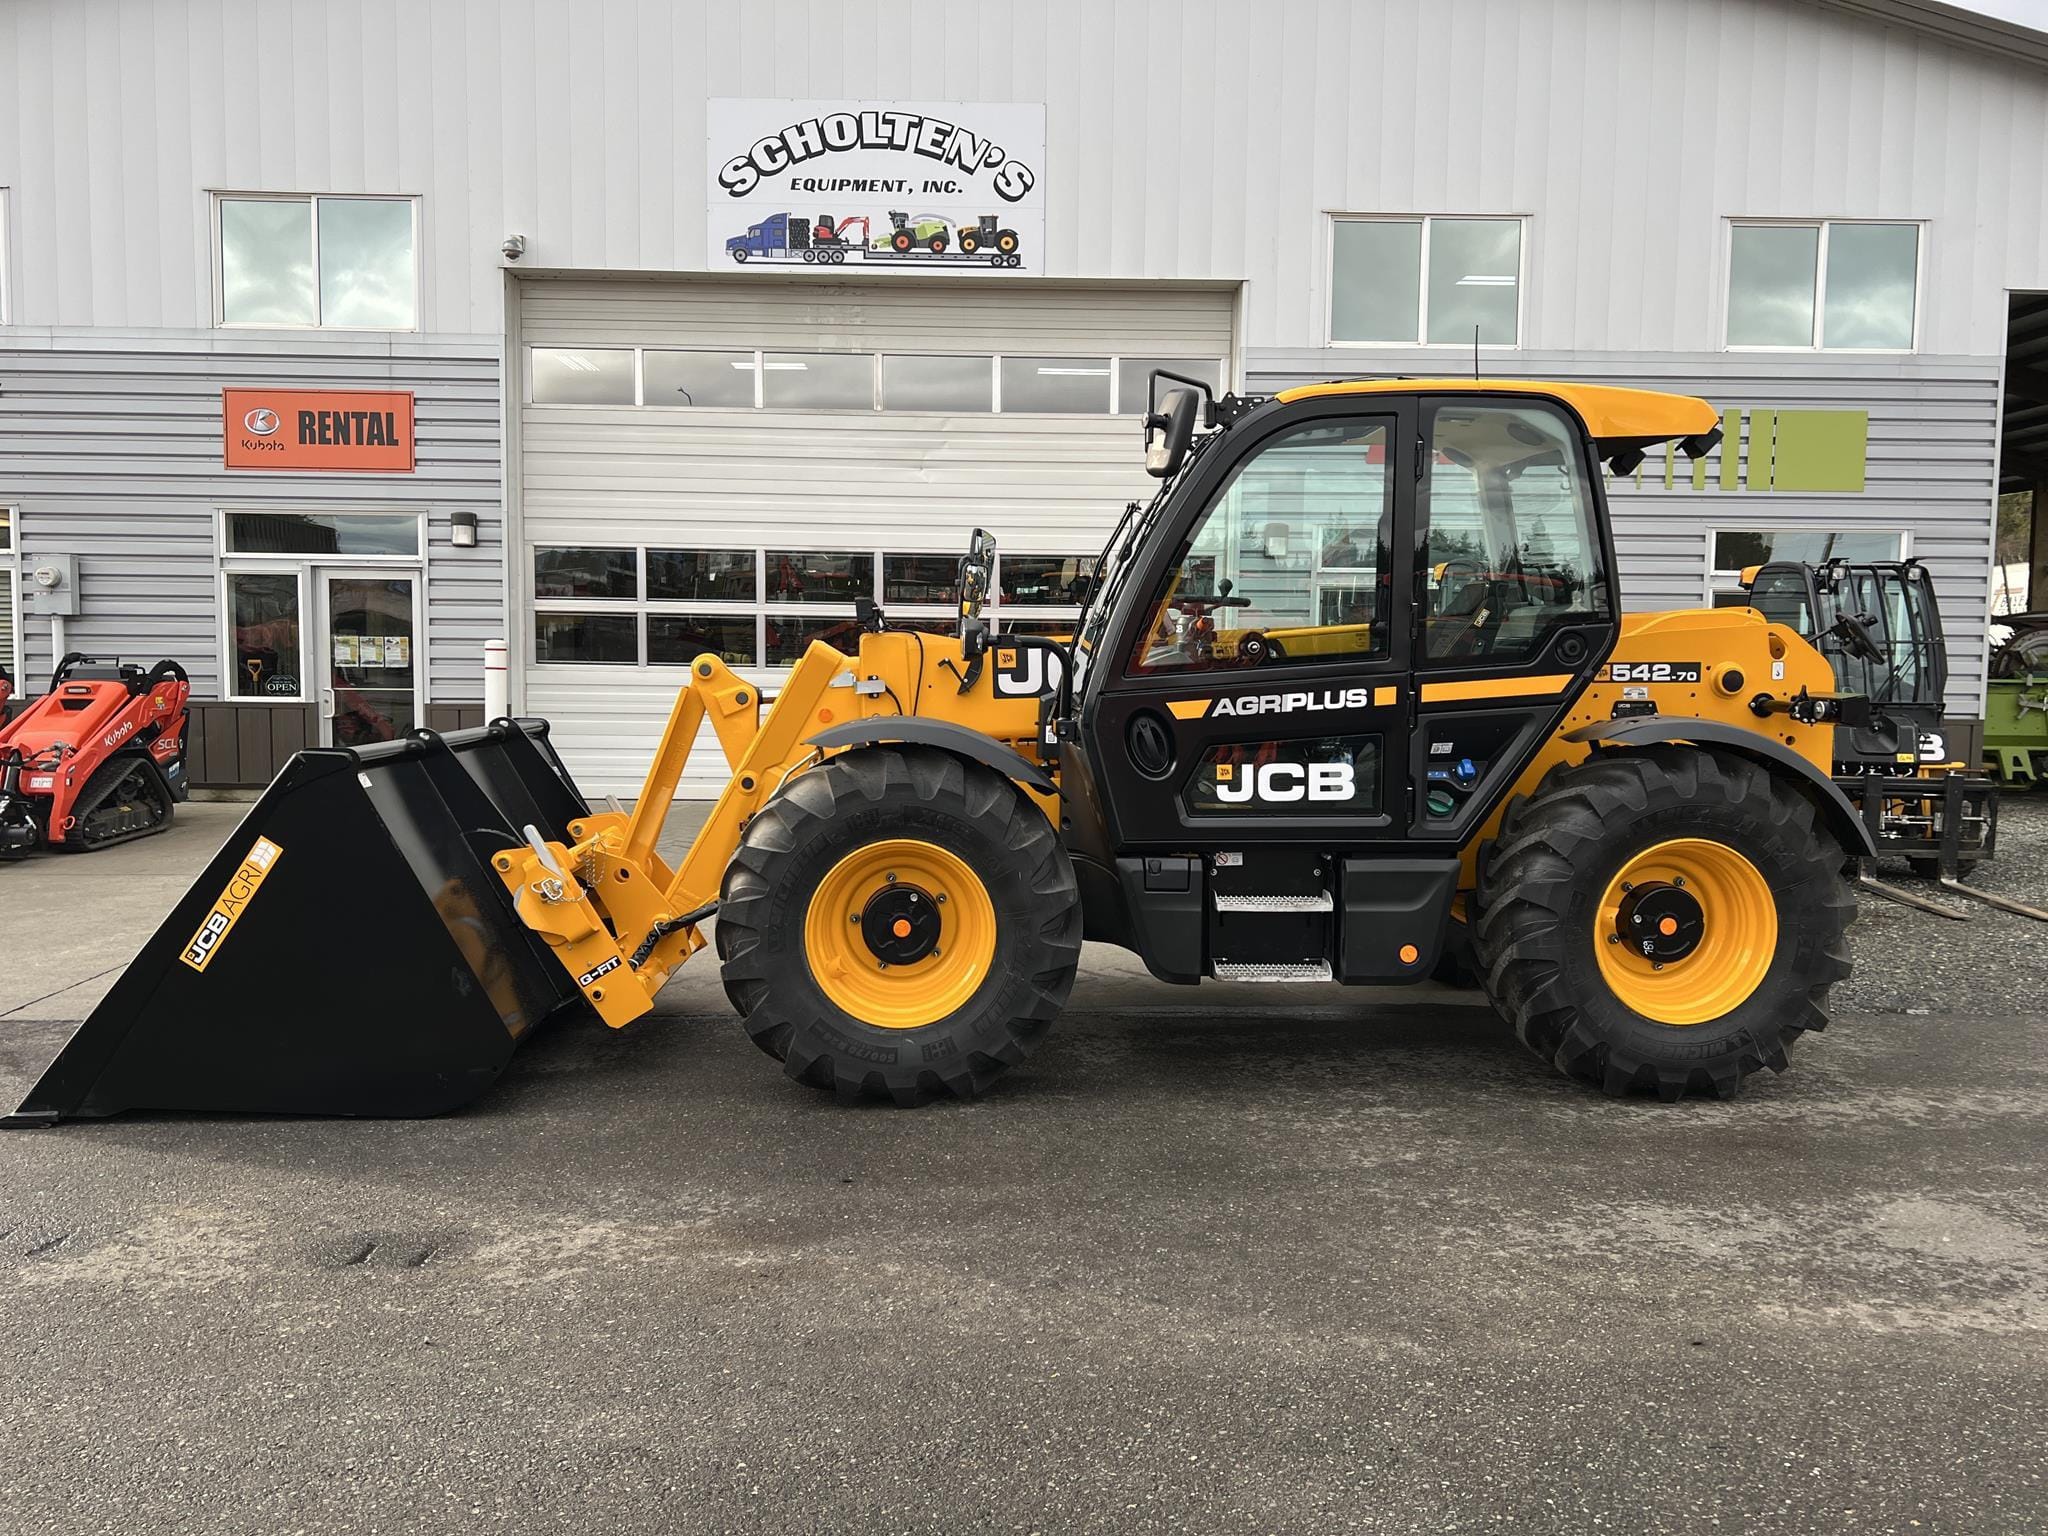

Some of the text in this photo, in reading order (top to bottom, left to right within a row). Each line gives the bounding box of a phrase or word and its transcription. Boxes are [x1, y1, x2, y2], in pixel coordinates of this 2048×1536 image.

[718, 111, 1035, 202] SCHOLTEN'S
[790, 178, 964, 195] EQUIPMENT, INC.
[298, 410, 399, 446] RENTAL
[241, 439, 285, 451] Kubota
[1611, 663, 1698, 682] 542-70
[267, 683, 297, 691] OPEN
[1211, 688, 1367, 717] AGRIPLUS
[103, 721, 133, 746] Kubota
[158, 738, 177, 749] SCL
[1216, 762, 1356, 802] JCB
[191, 863, 263, 964] JCB AGRI
[579, 956, 618, 986] Q-FIT
